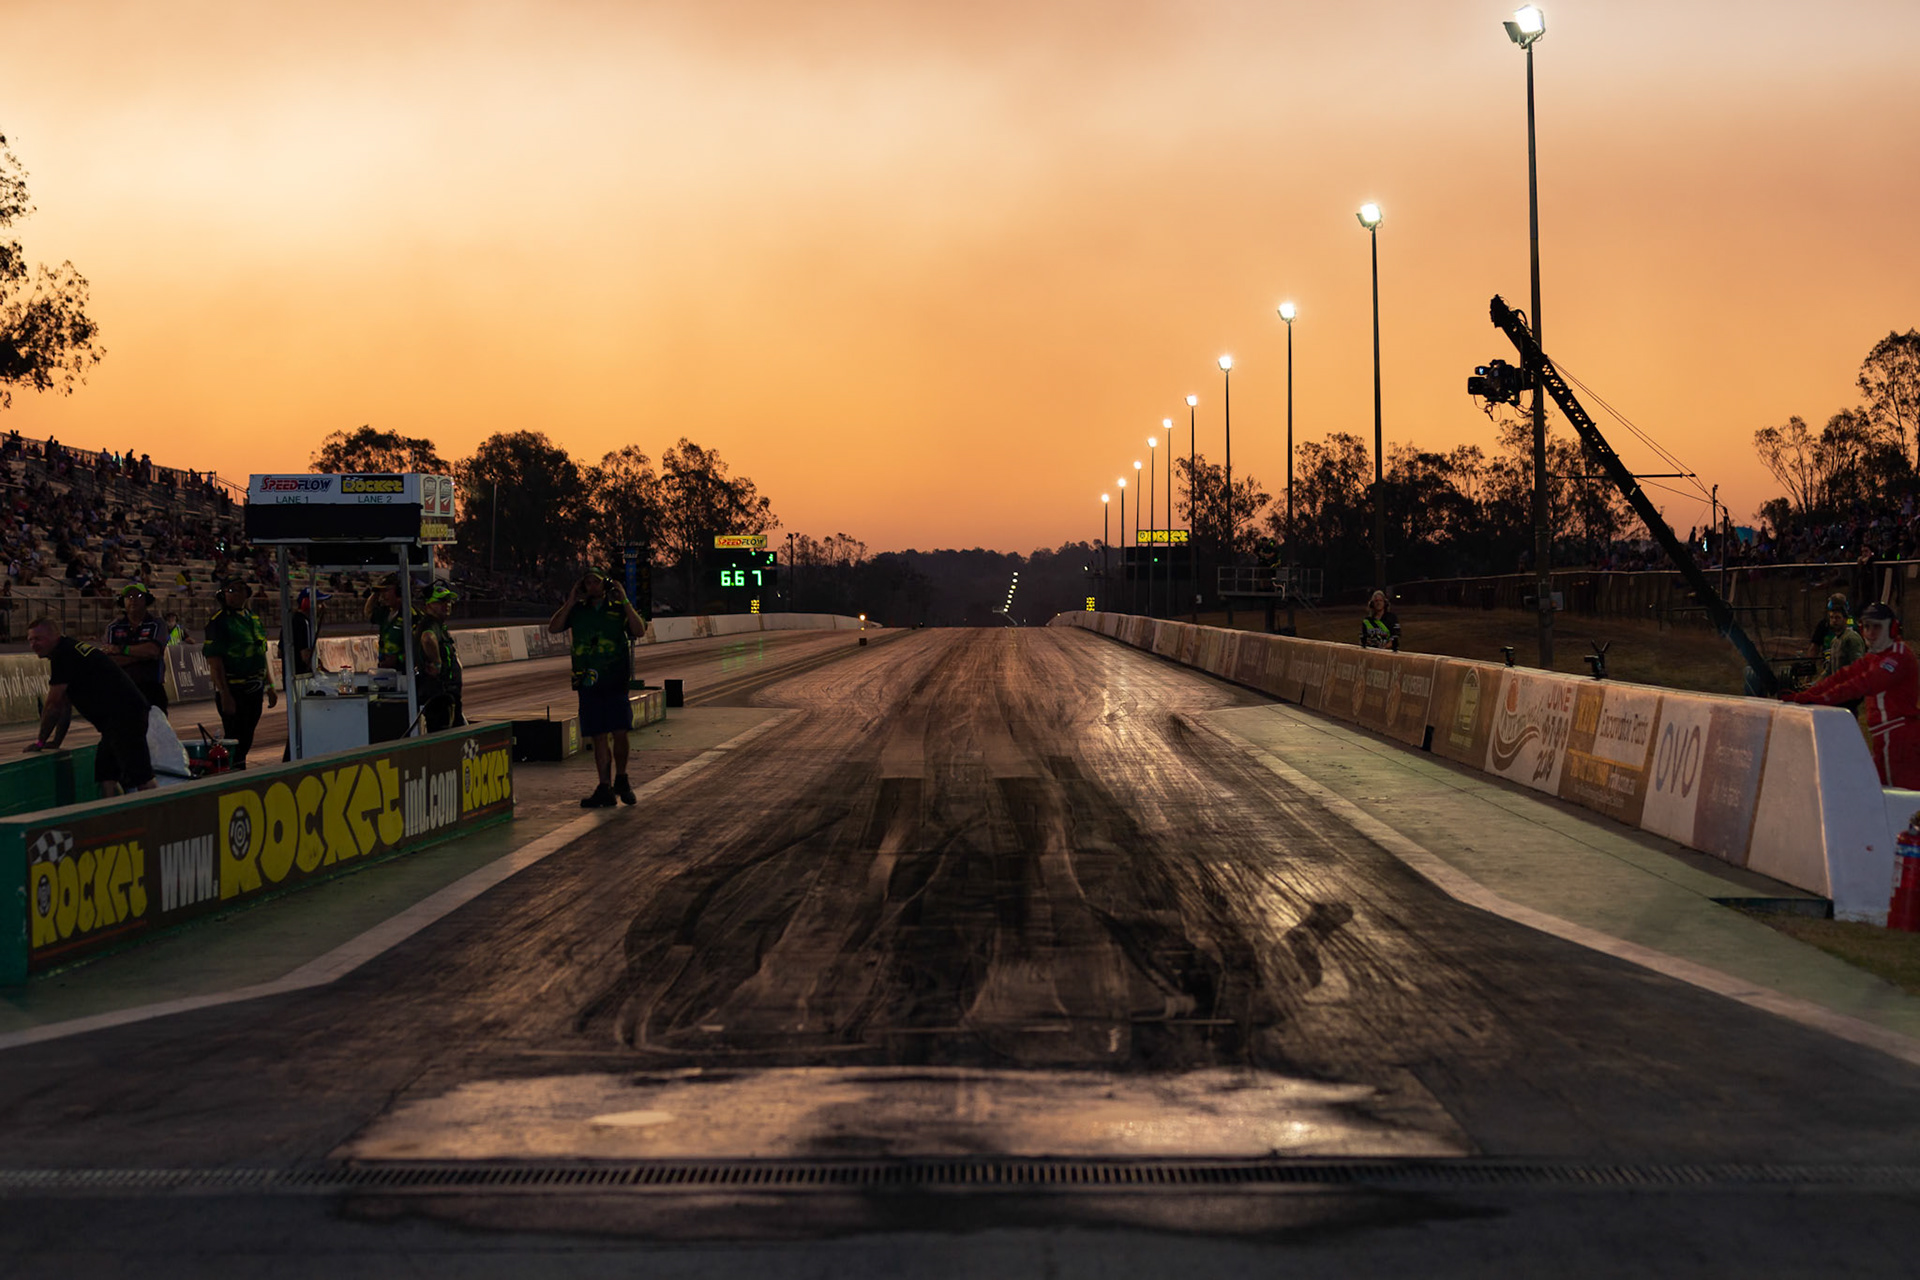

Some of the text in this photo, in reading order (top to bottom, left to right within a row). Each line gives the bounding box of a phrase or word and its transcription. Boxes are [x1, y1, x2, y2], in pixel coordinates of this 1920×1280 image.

[260, 477, 331, 492] SPEEDFLOW
[275, 496, 302, 504] LANE
[357, 495, 392, 504] LANE 2
[717, 537, 765, 547] SPEEDFLOW
[12, 666, 23, 697] of
[1547, 682, 1573, 713] JUNE
[1656, 721, 1700, 799] OVO
